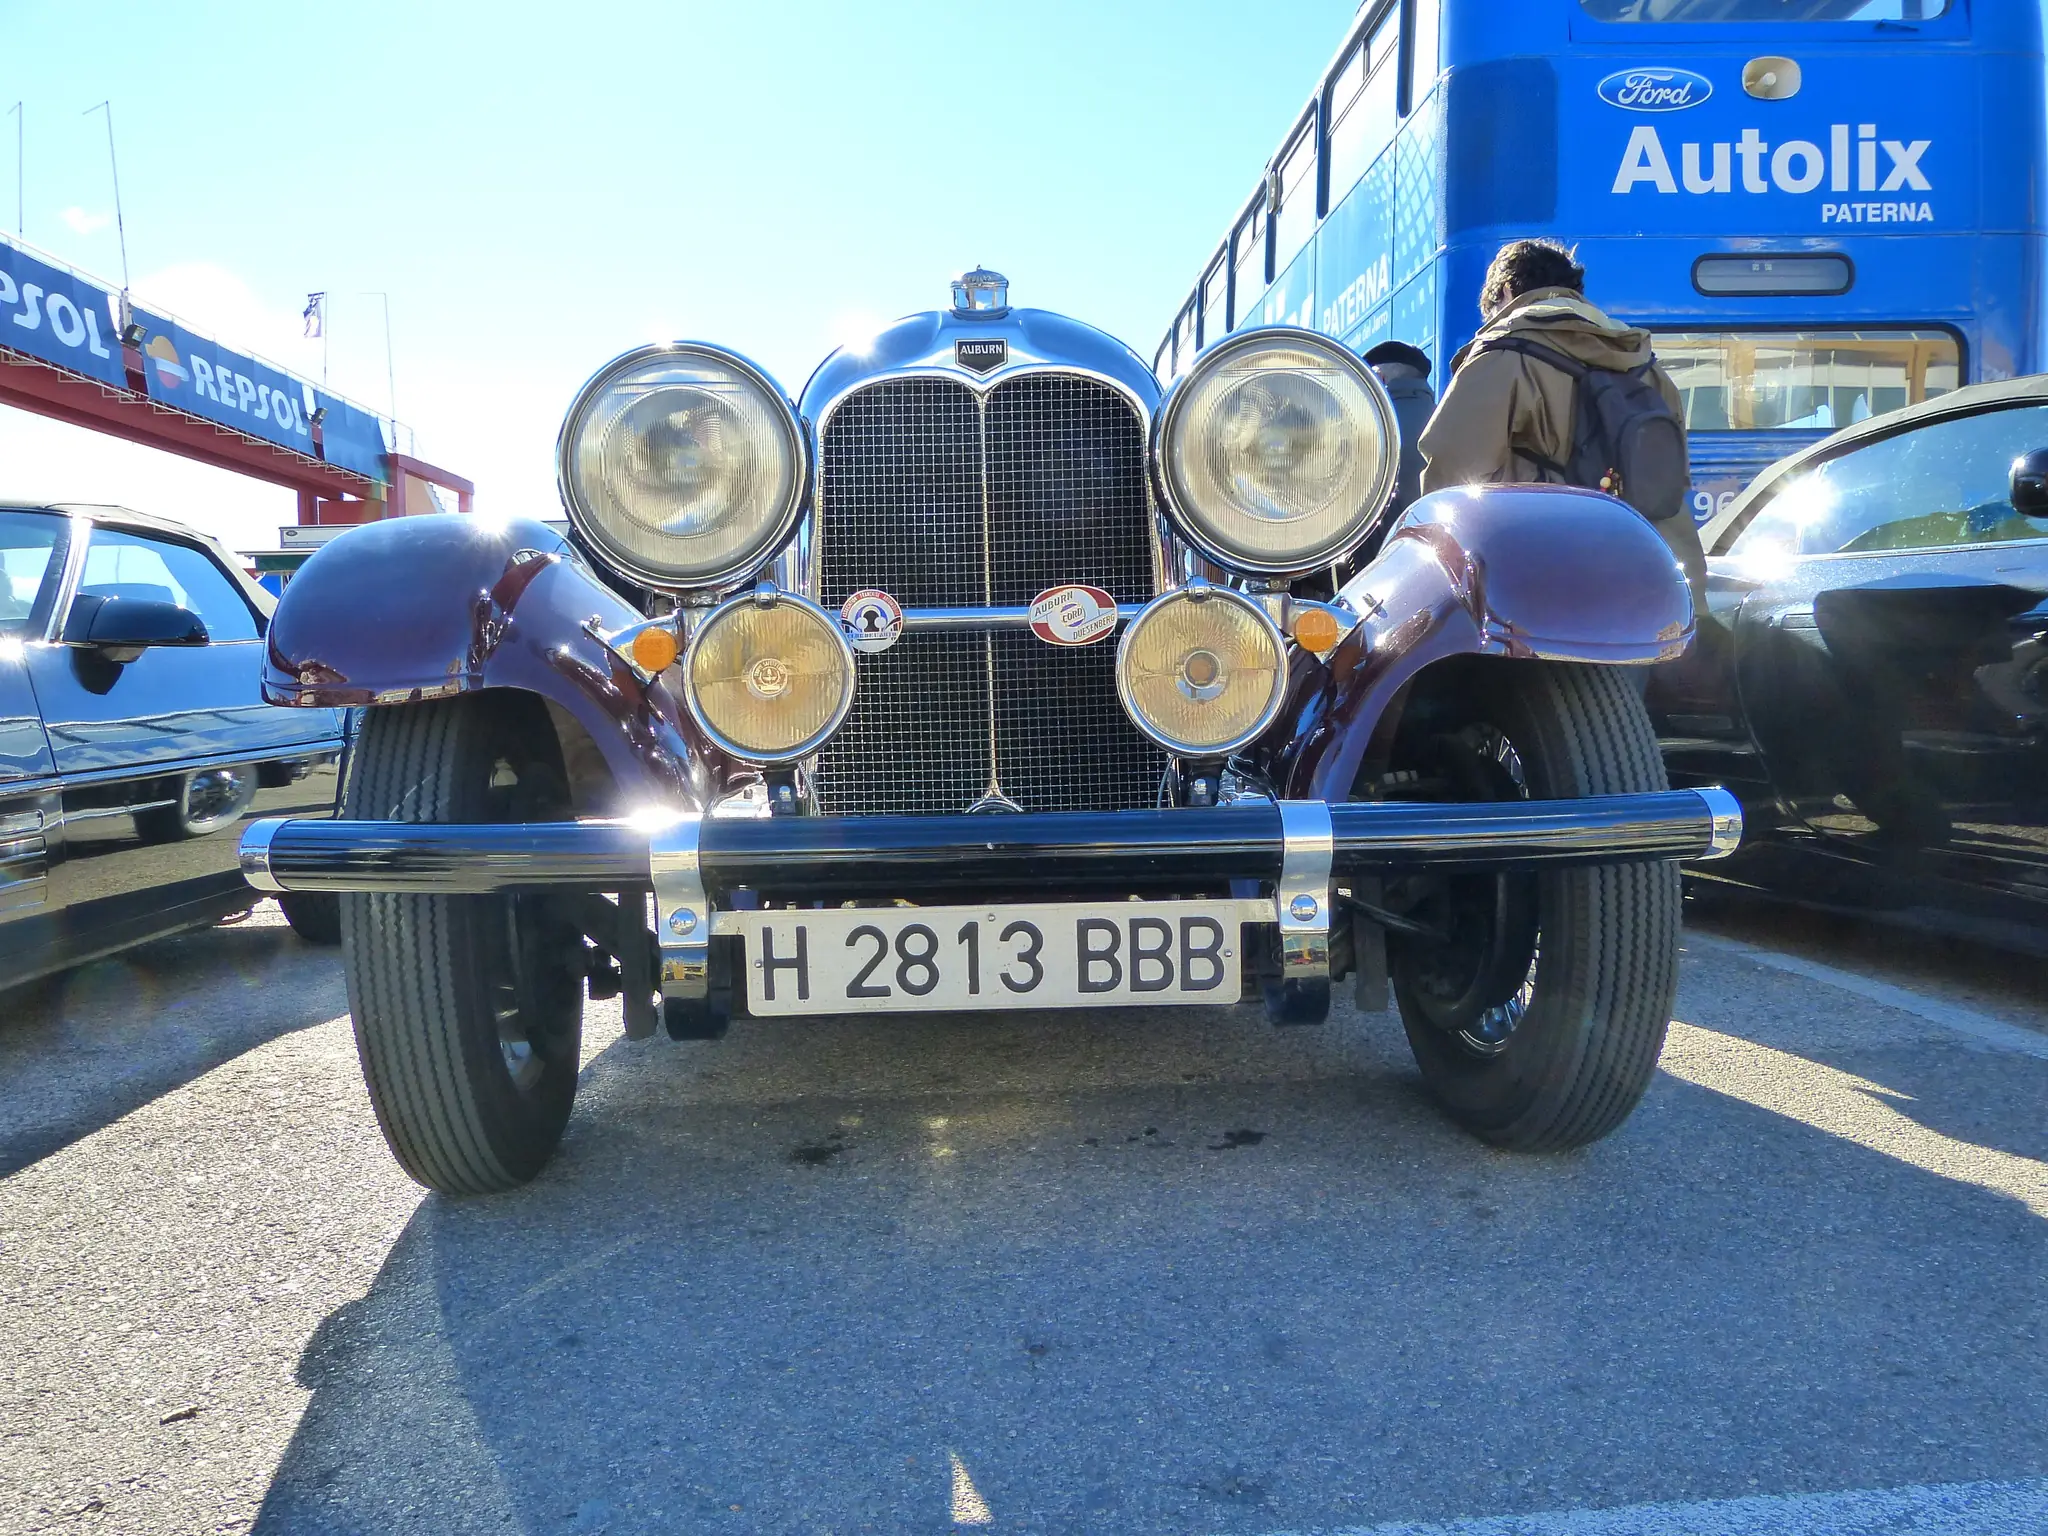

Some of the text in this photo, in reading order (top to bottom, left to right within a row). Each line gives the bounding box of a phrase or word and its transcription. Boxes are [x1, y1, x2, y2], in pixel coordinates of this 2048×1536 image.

[1618, 74, 1693, 104] Ford
[1611, 124, 1932, 194] Autolix
[1822, 203, 1934, 223] PATERNA
[1323, 253, 1389, 337] PATERNA
[960, 344, 1003, 355] AUBURN
[190, 353, 308, 436] REPSOL
[1034, 590, 1074, 617] AUBURN
[1062, 607, 1083, 623] CORD
[1073, 614, 1116, 640] DUESENBERG
[762, 916, 1225, 1001] H 2813 BBB
